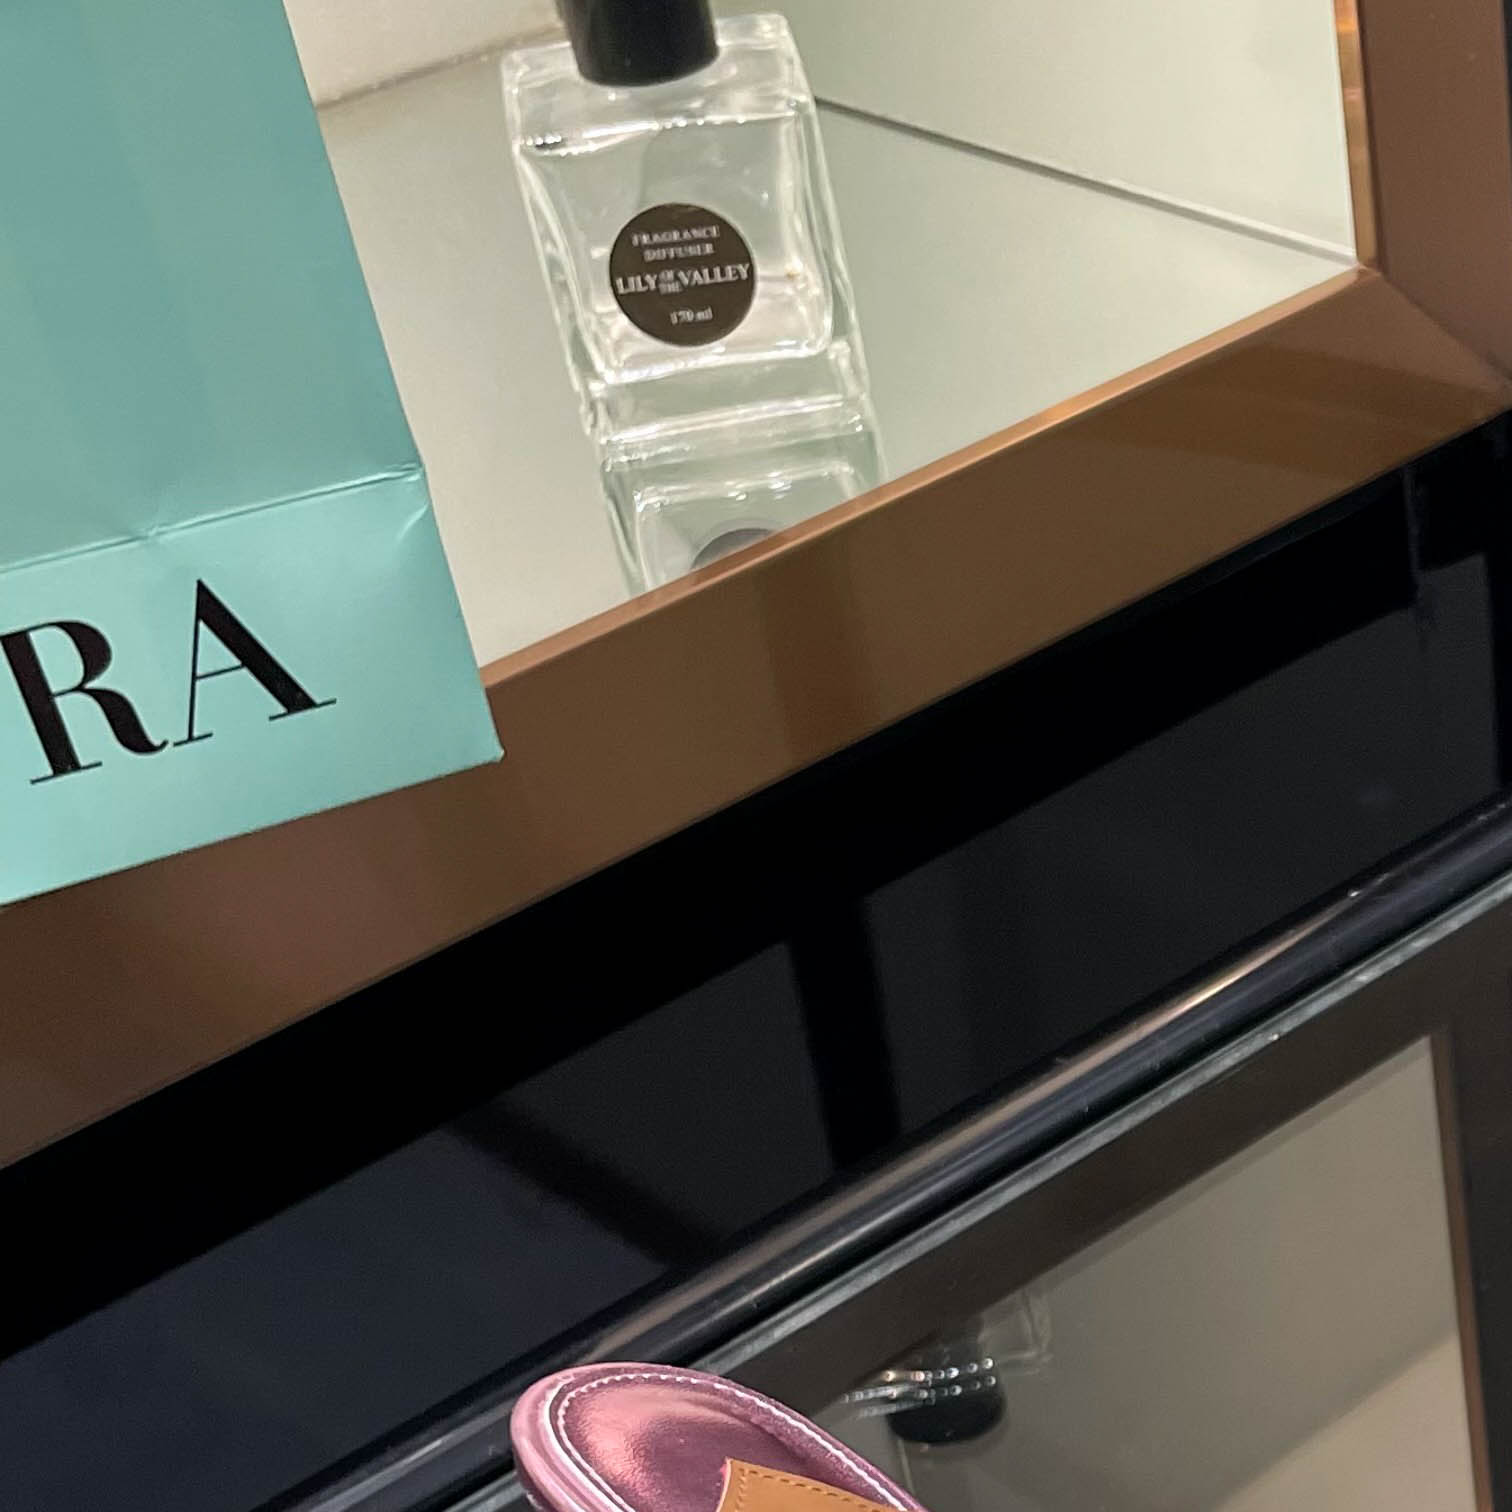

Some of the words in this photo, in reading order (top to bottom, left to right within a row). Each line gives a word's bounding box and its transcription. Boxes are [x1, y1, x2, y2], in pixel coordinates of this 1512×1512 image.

[632, 226, 719, 246] FRAGRANCE
[616, 274, 658, 294] LILY
[678, 264, 750, 286] VALLEY
[0, 578, 337, 785] RA
